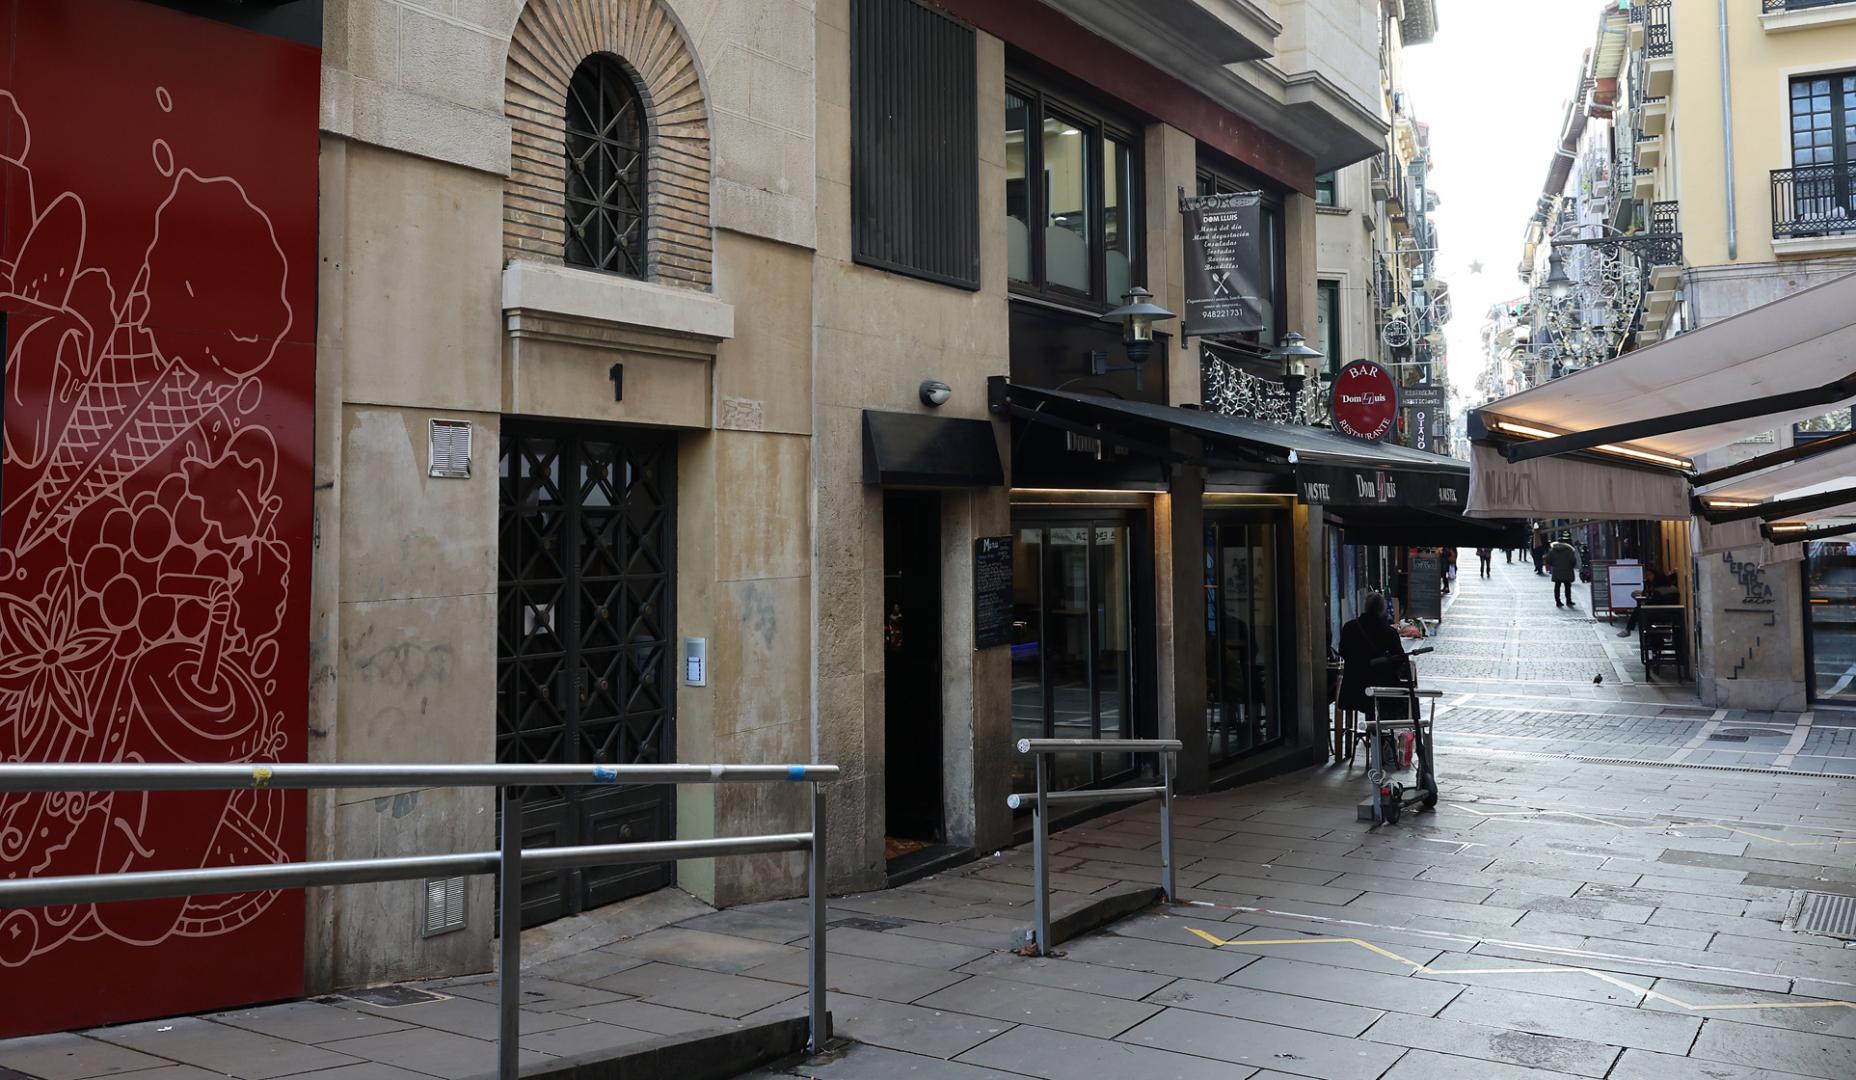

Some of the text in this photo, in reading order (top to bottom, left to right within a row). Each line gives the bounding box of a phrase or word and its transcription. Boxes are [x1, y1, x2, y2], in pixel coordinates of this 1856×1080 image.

[1203, 215, 1220, 223] DOM
[1202, 308, 1243, 319] 948221731
[1348, 365, 1378, 378] BAR
[609, 363, 623, 401] 1
[1339, 417, 1391, 440] RESTAURANTE
